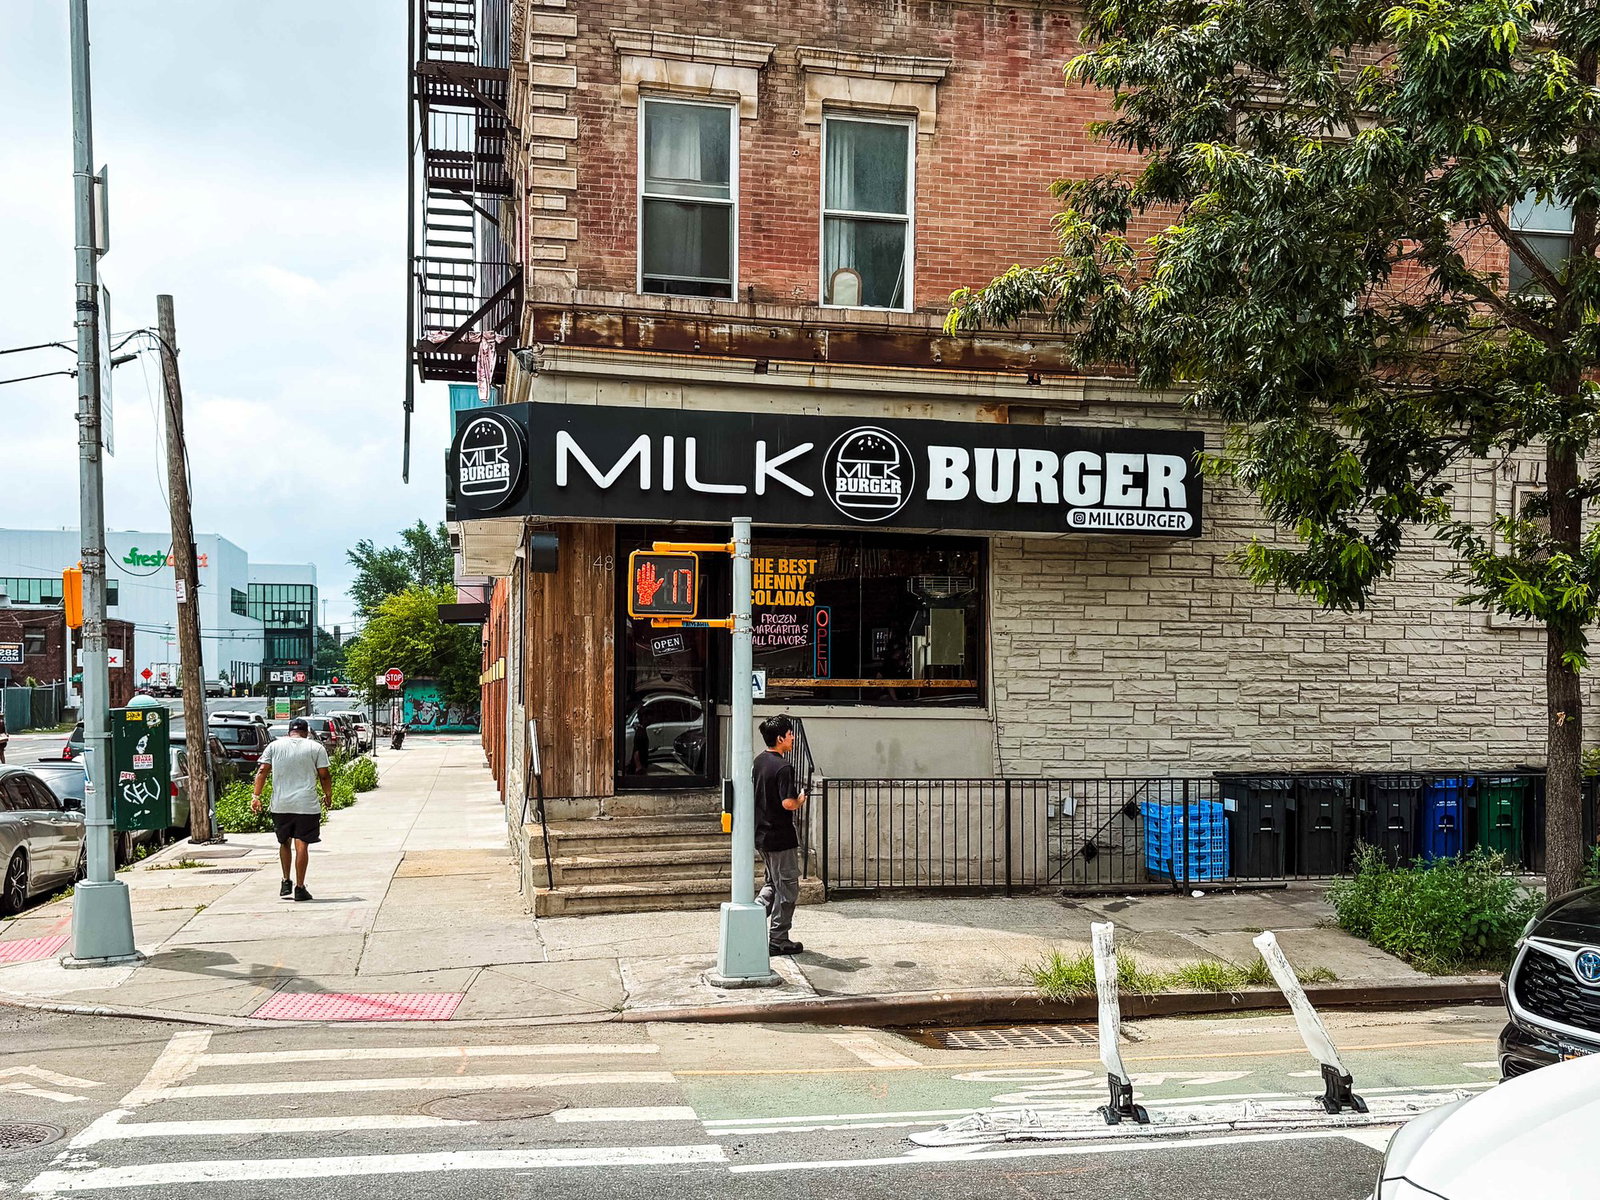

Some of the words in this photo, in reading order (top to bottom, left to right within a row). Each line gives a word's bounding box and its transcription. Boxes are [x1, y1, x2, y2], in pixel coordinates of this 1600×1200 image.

[459, 447, 509, 468] MILK
[556, 430, 814, 497] MILK
[459, 462, 510, 482] BURGER
[836, 461, 901, 480] MILK
[926, 445, 1188, 508] BURGER
[835, 477, 902, 494] BURGER
[1088, 511, 1186, 529] MILKBURGER
[778, 559, 817, 574] BEST
[753, 574, 807, 590] HENNY
[761, 613, 797, 624] FROZEN
[653, 637, 680, 650] OPEN
[752, 635, 767, 646] ALL
[768, 634, 807, 646] FLAVORS
[816, 609, 829, 676] OPEN
[386, 673, 402, 682] STOP
